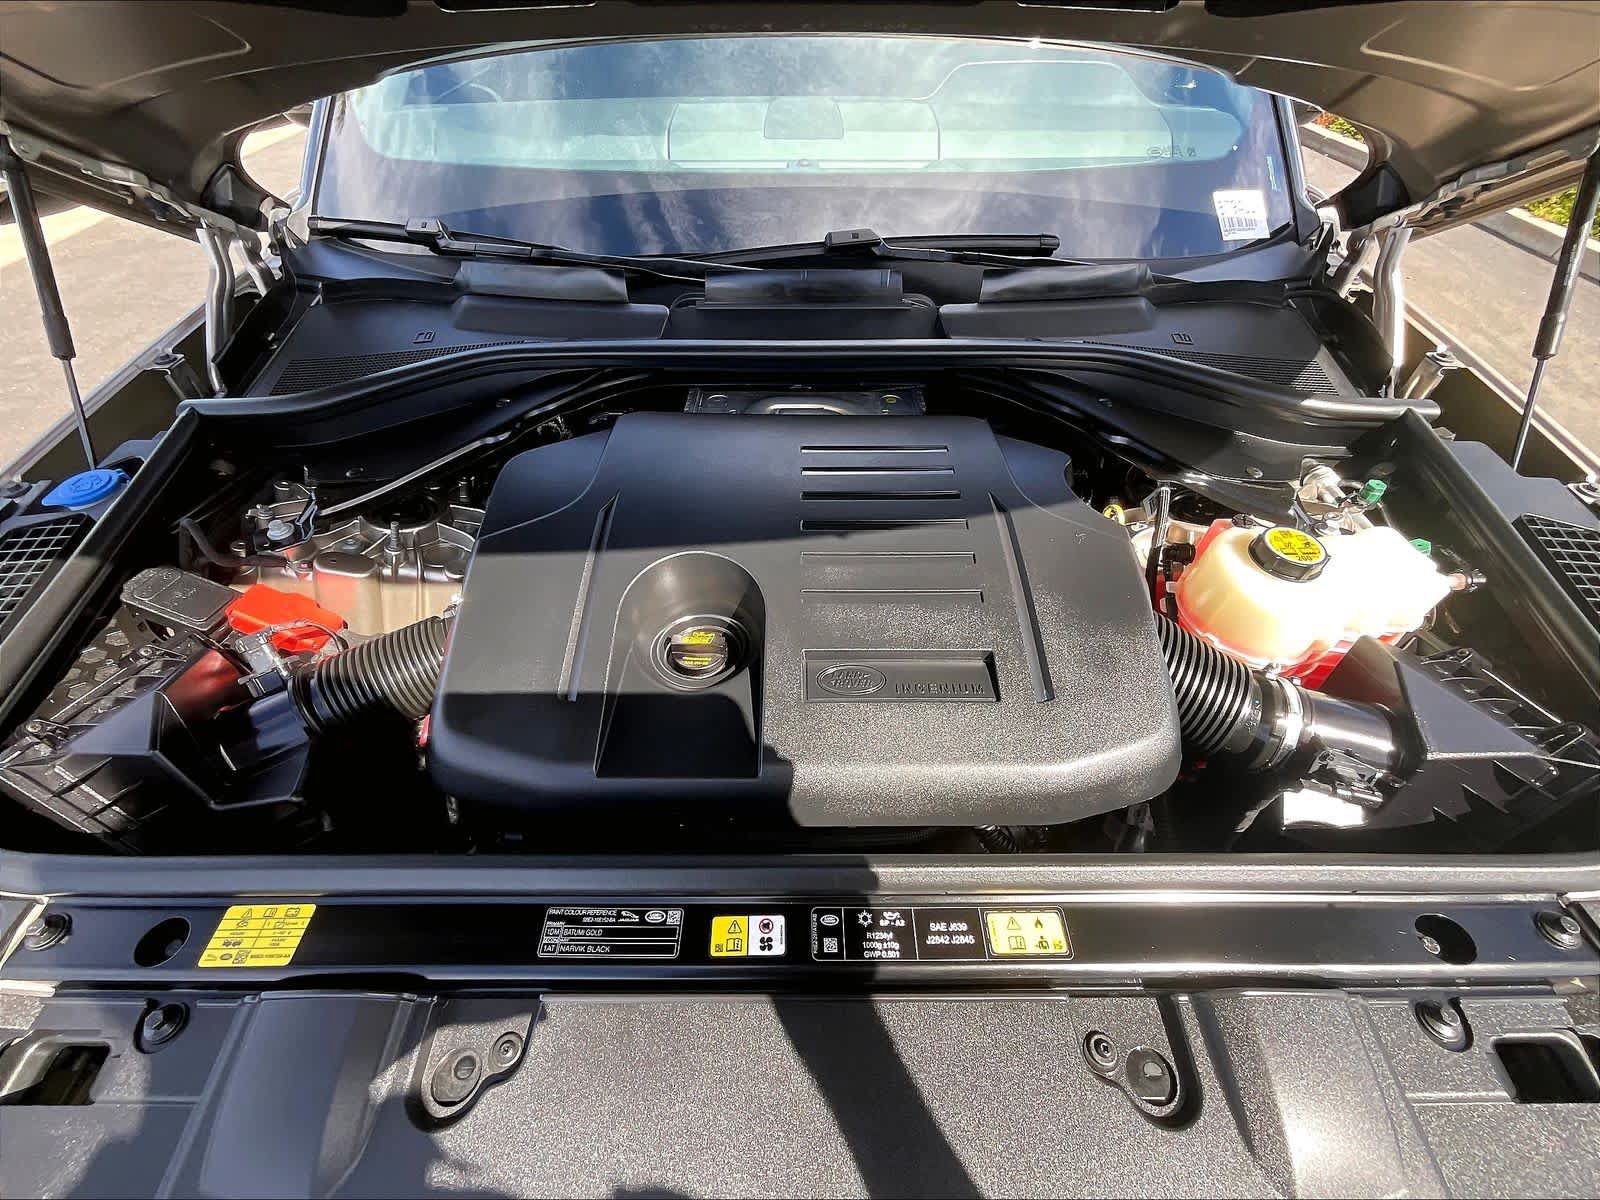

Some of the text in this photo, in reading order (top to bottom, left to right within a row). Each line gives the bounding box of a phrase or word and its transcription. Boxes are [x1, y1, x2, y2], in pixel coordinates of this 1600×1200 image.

[895, 683, 985, 695] INGENIUM
[929, 922, 948, 931] SAE
[563, 928, 585, 936] BATUMI
[585, 928, 603, 936] GOLD
[544, 944, 610, 953] 1AT NARVIK BLACK
[863, 950, 881, 958] GWP
